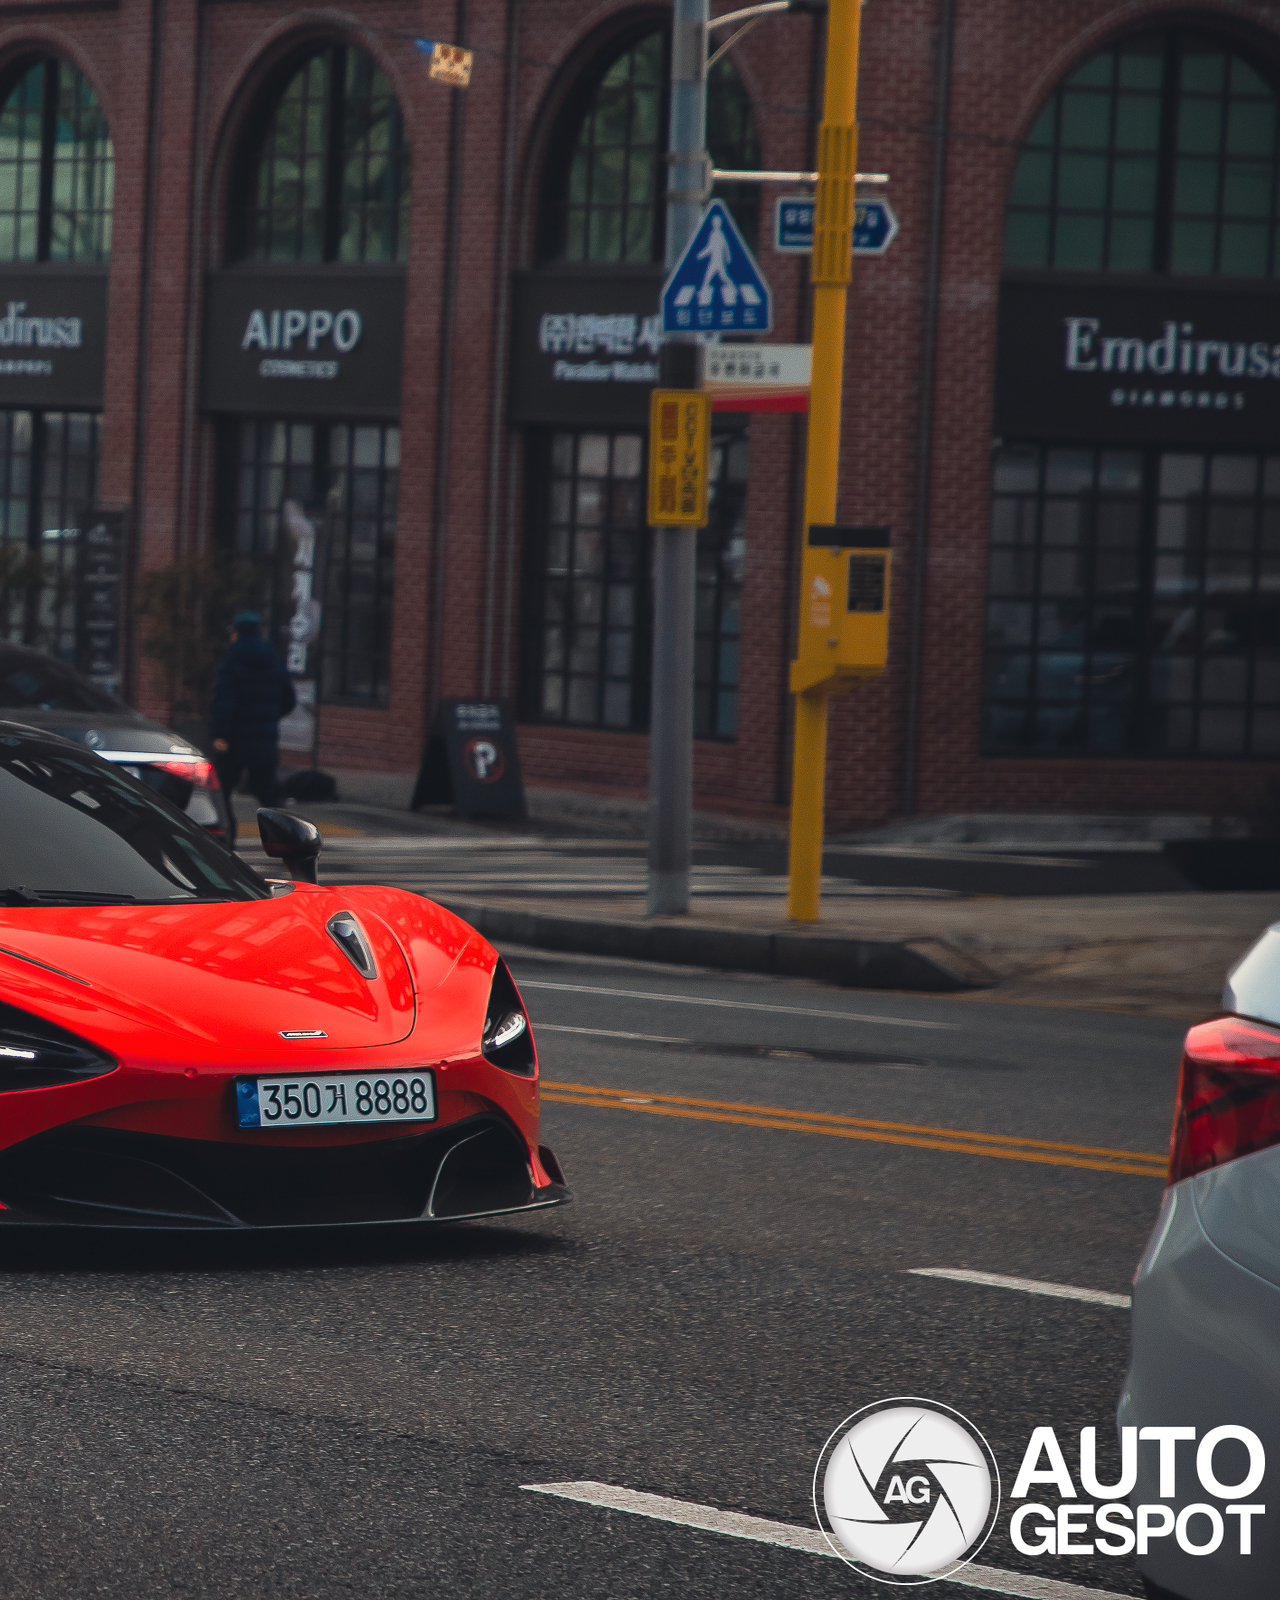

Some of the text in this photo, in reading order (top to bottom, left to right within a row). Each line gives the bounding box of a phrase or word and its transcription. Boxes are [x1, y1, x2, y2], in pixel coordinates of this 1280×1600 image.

[241, 308, 362, 353] AIPPO
[1110, 387, 1245, 410] DIAMONDS
[262, 1078, 428, 1120] 350거 8888
